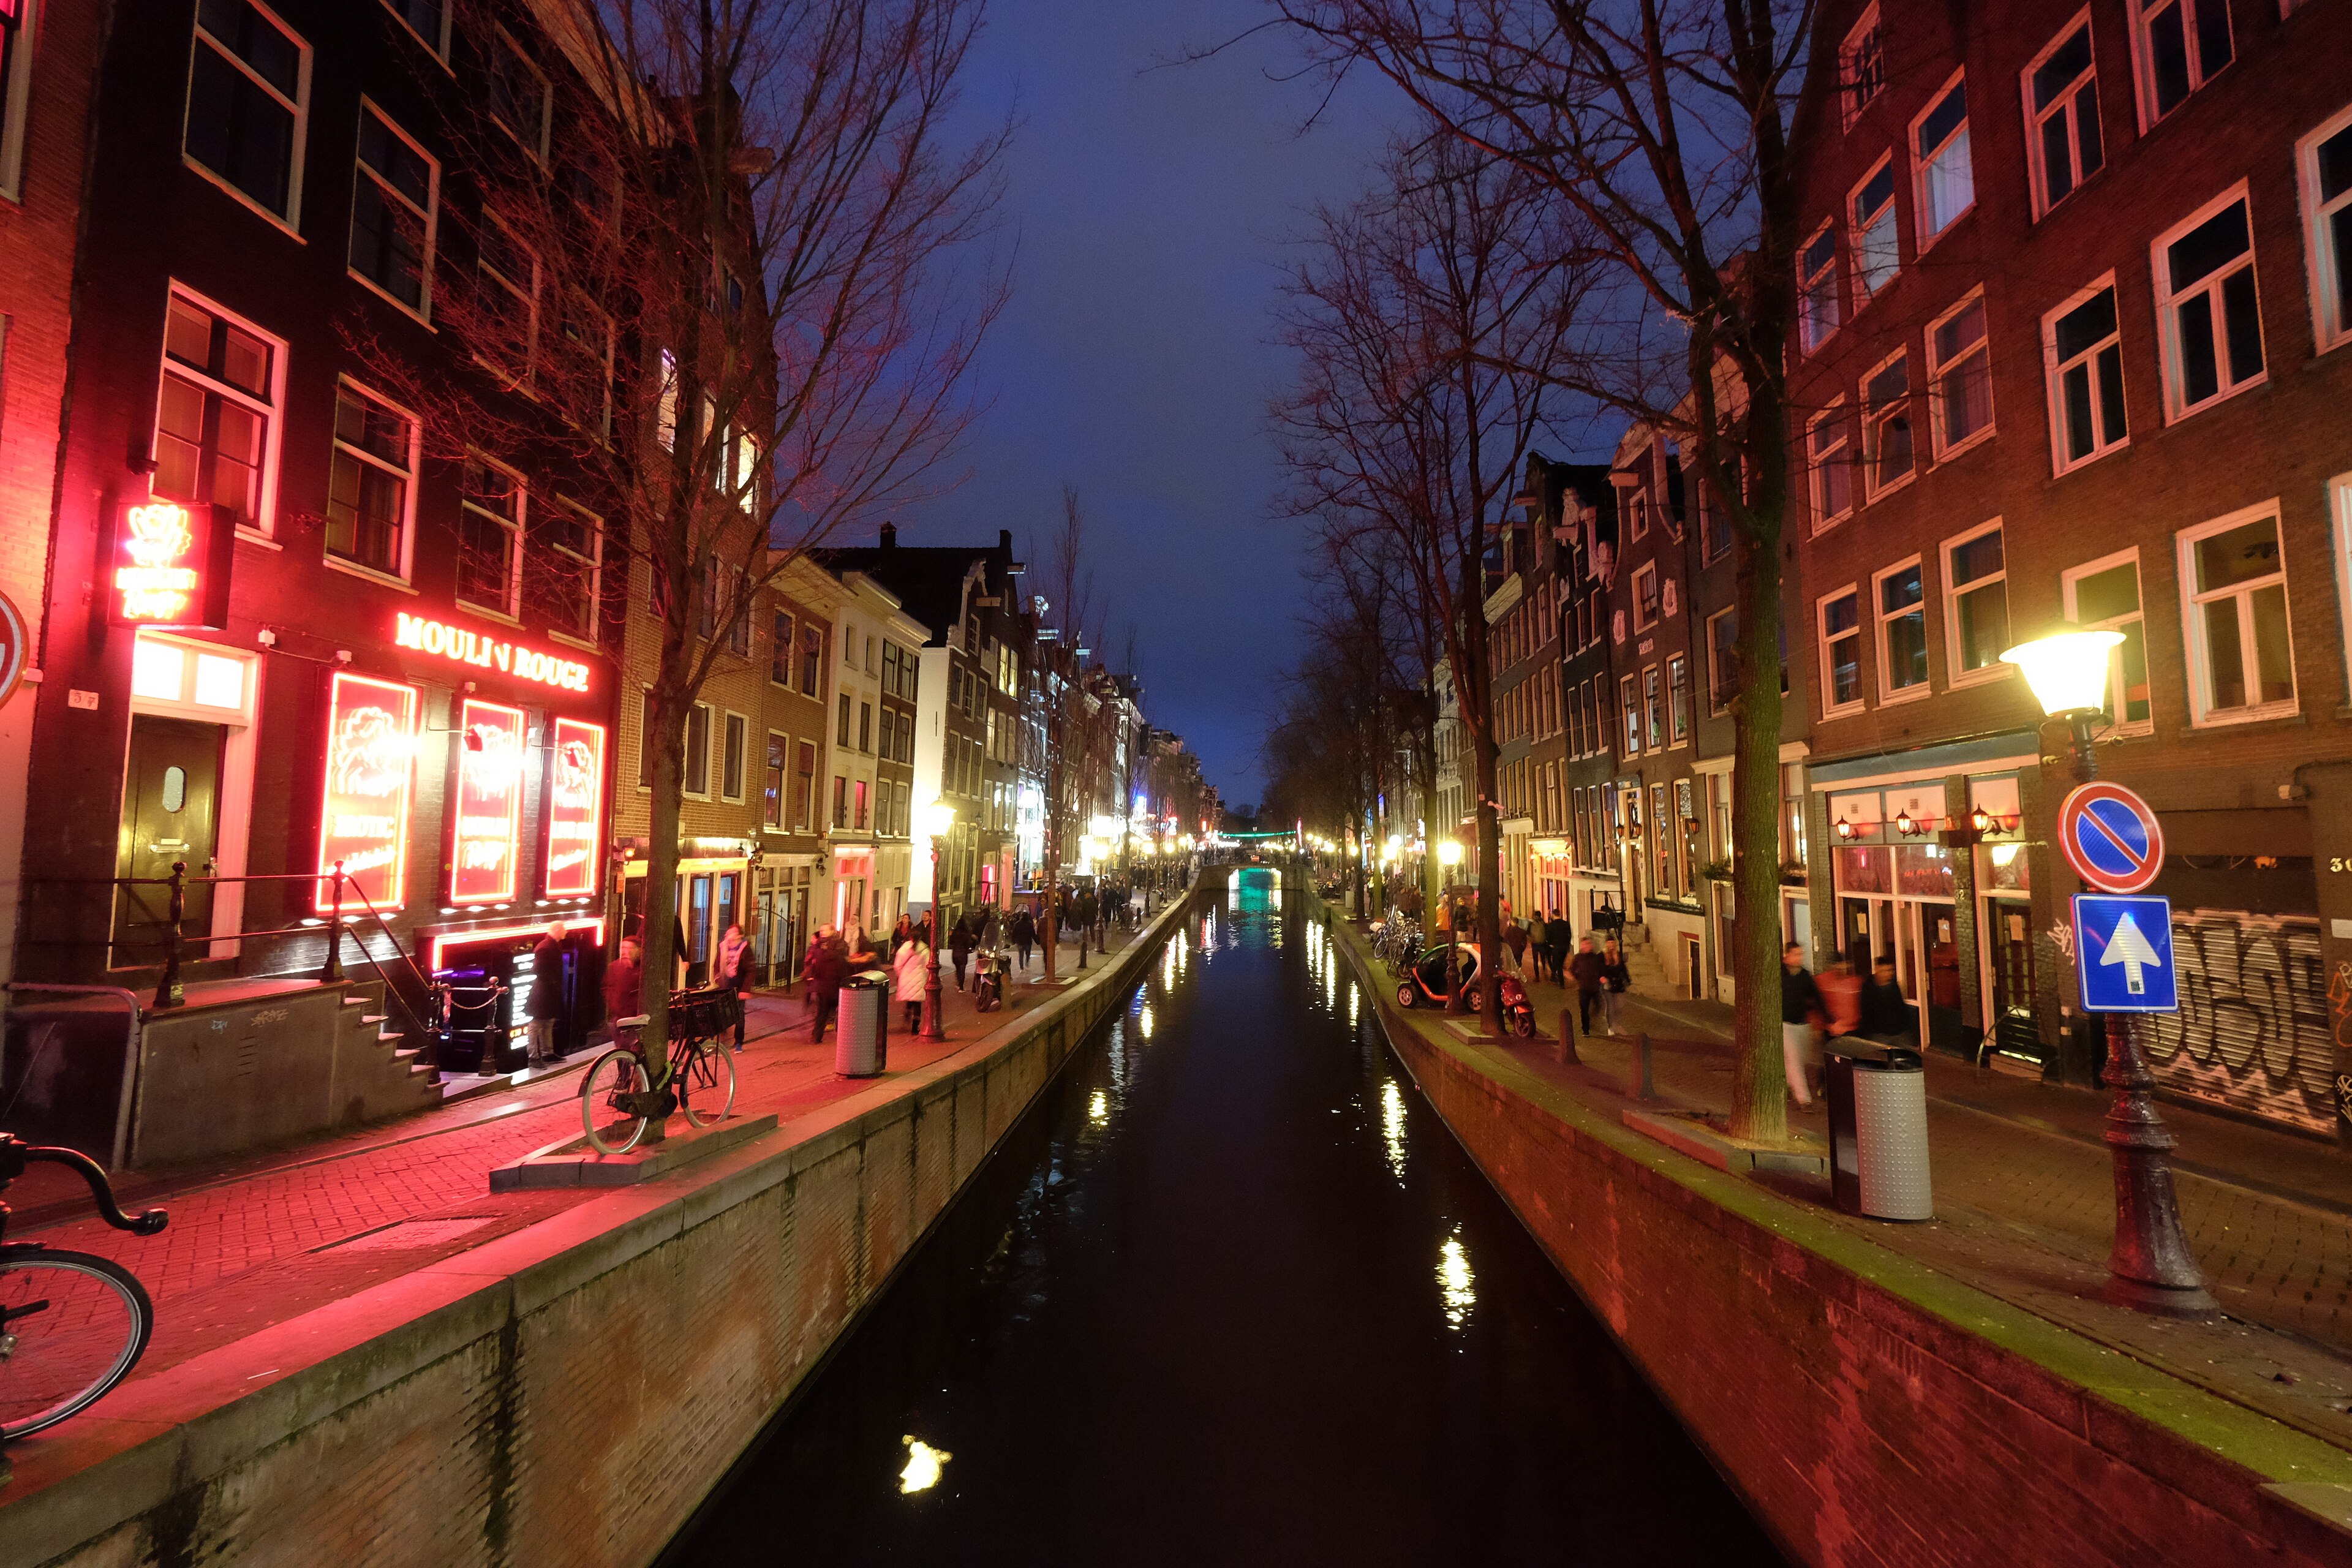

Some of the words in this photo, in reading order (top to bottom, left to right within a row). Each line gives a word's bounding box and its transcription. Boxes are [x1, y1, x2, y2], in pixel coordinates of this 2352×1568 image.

[396, 612, 511, 671] MOULIN
[513, 647, 589, 692] ROUGE
[74, 693, 96, 707] 57
